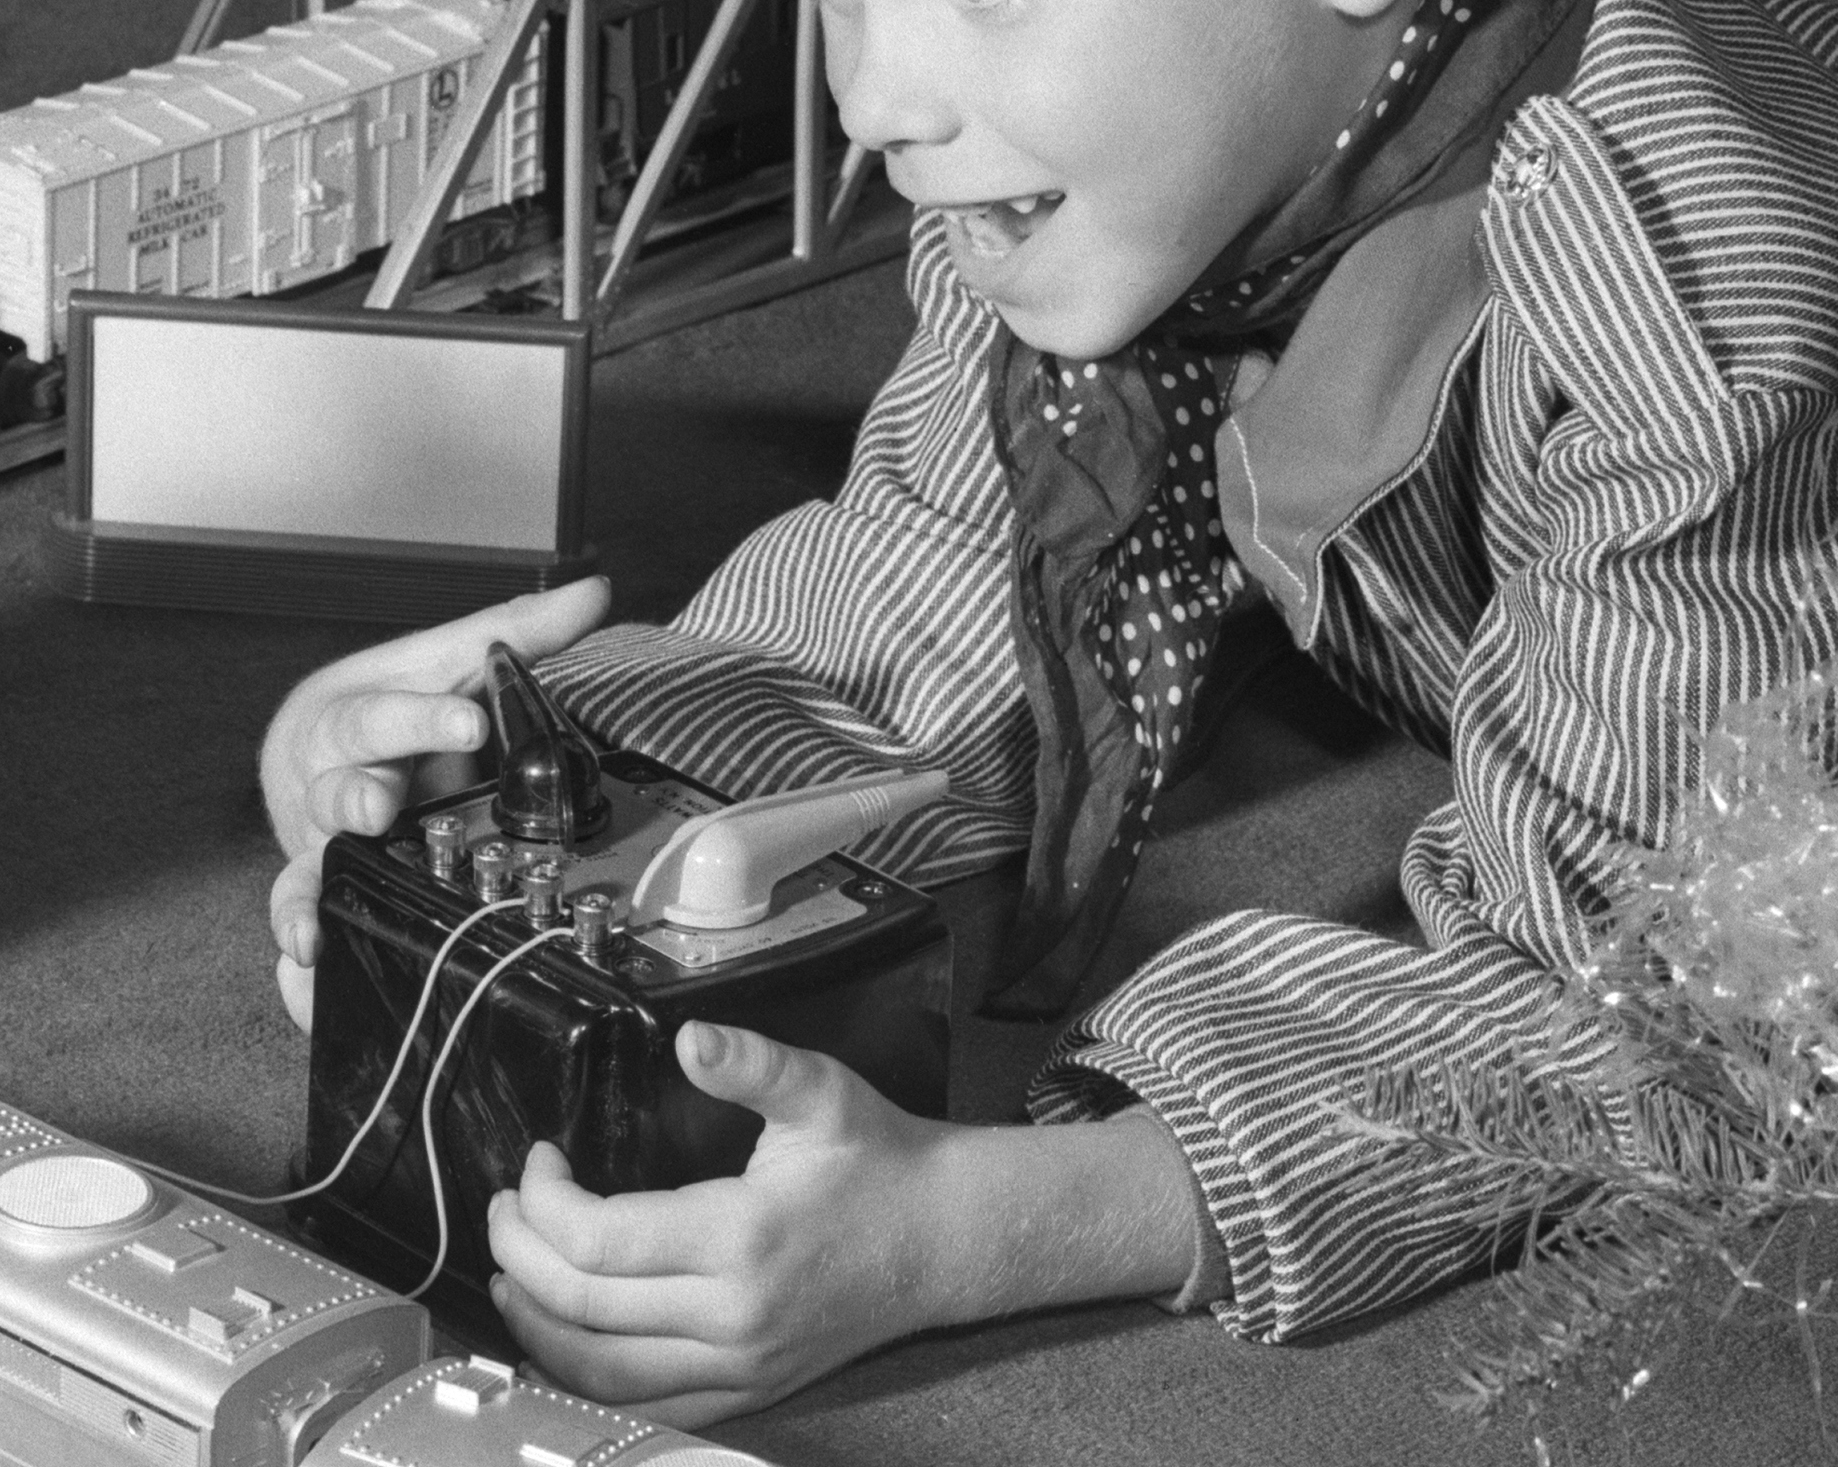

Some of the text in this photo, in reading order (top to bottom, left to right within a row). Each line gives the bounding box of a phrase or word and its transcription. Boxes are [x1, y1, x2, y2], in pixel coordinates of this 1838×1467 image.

[127, 201, 226, 244] REFRIGERATED
[138, 187, 217, 224] AUTOMATIC
[138, 224, 208, 257] MILK CAR
